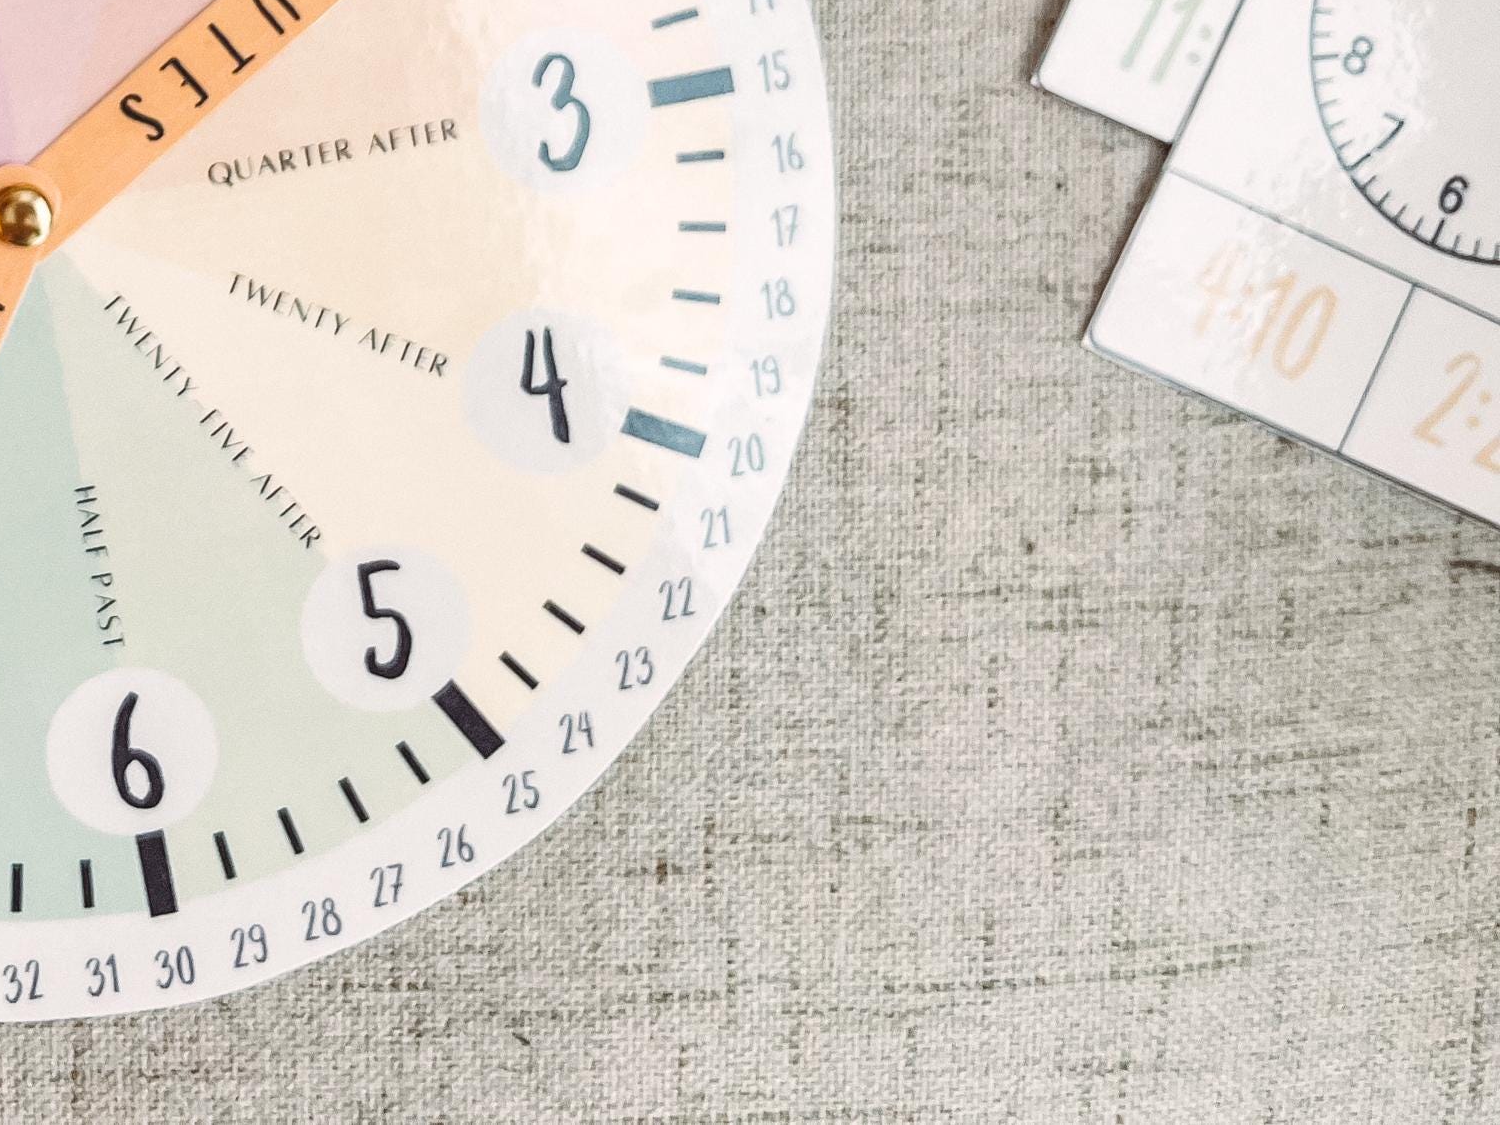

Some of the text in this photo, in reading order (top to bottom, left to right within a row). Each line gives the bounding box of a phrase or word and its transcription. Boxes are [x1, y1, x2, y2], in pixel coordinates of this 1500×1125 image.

[757, 49, 792, 94] 15
[1343, 35, 1374, 75] 8
[531, 52, 592, 173] 3
[1378, 111, 1405, 149] 7
[208, 118, 458, 187] QUARTER AFTER
[771, 132, 806, 174] 16
[1439, 175, 1469, 214] 6
[770, 204, 799, 247] 17
[760, 277, 797, 320] 18
[229, 271, 448, 377] TWENTY AFTER
[520, 326, 571, 445] 4
[749, 355, 781, 397] 19
[727, 433, 766, 478] 20
[250, 474, 321, 549] AFTER
[700, 505, 733, 550] 21
[74, 485, 125, 646] HALF PAST
[357, 559, 413, 680] 5
[659, 577, 696, 622] 22
[615, 646, 655, 691] 23
[111, 692, 165, 810] 6
[559, 711, 594, 755] 24
[502, 770, 540, 815] 25
[437, 824, 476, 868] 26
[369, 863, 403, 908] 27
[302, 897, 342, 941] 28
[154, 946, 195, 989] 30
[230, 924, 268, 968] 29
[3, 960, 44, 1004] 32
[85, 954, 120, 997] 31
